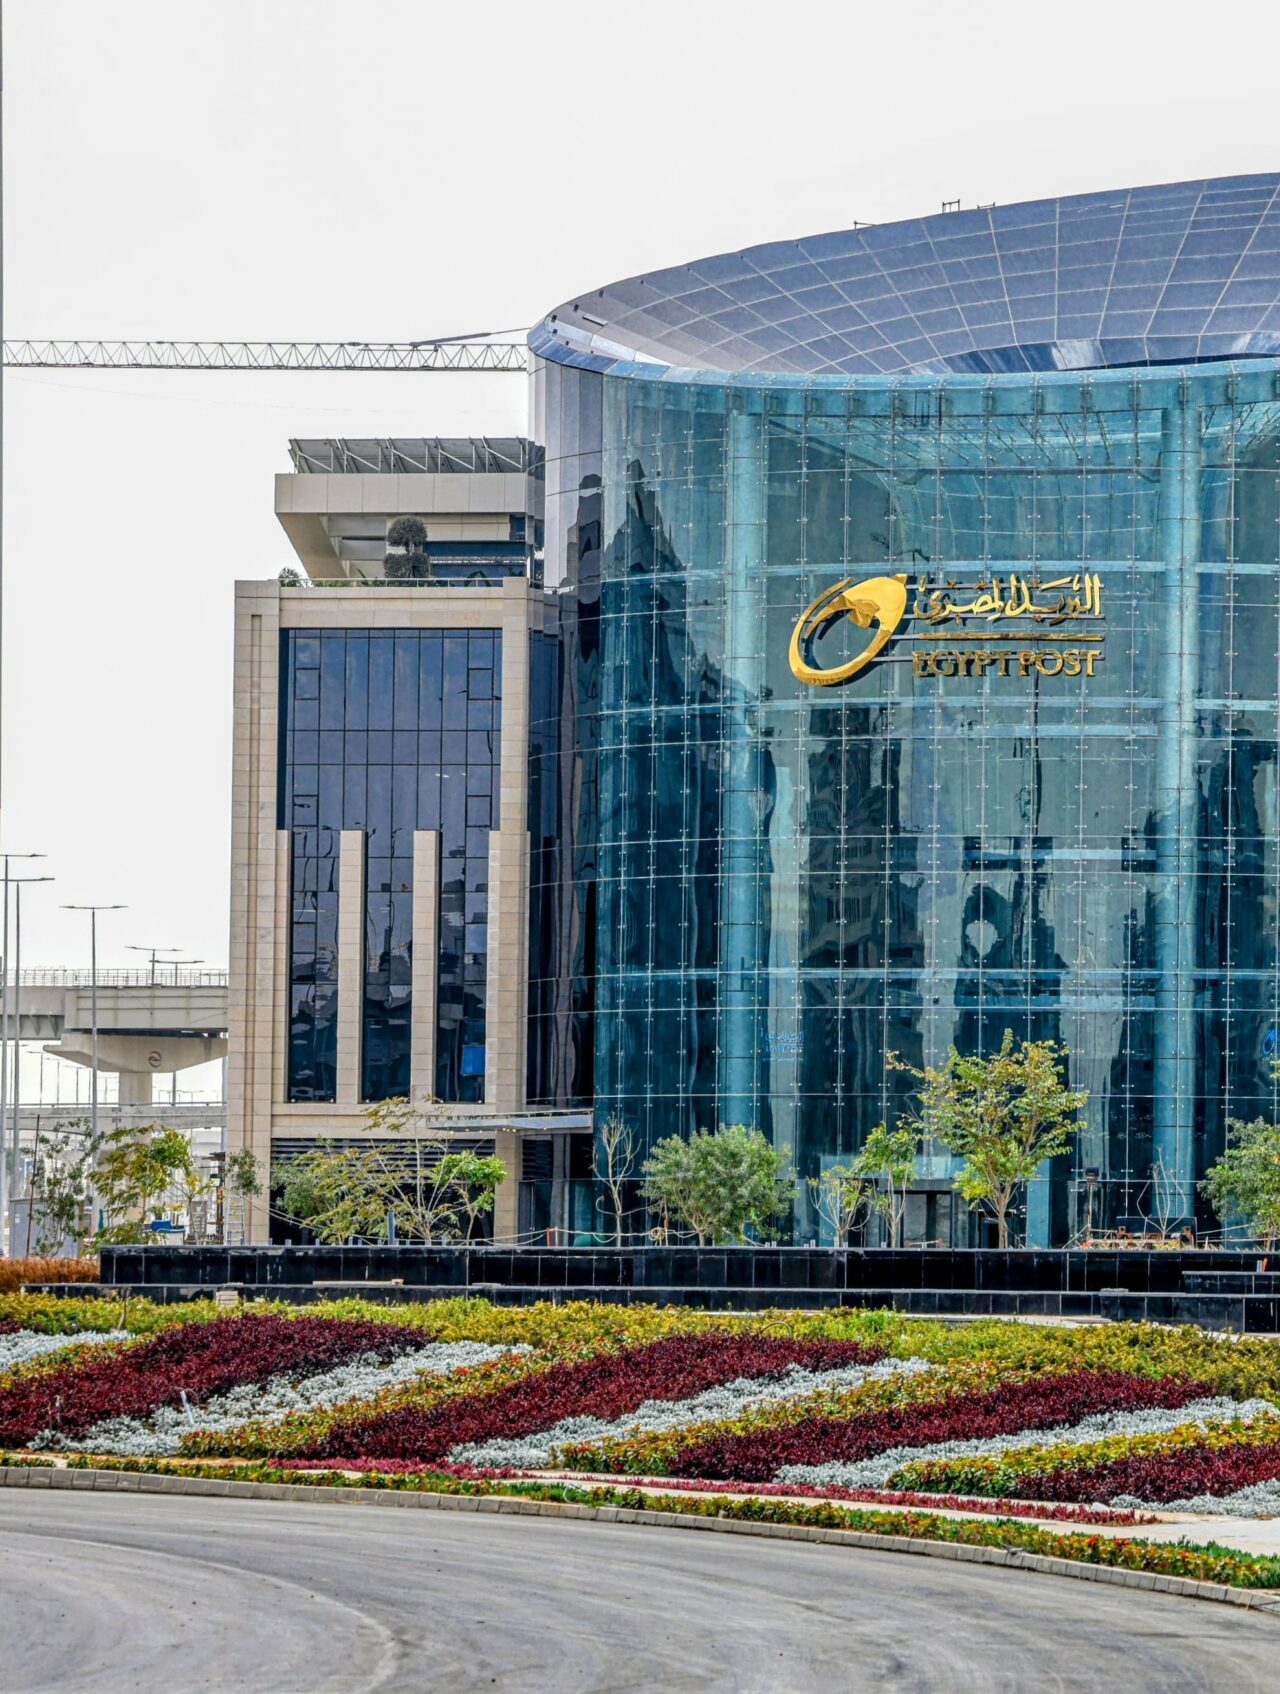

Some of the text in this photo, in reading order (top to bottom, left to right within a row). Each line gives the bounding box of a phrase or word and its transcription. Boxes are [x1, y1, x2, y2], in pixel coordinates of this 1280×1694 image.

[1005, 573, 1101, 626] البريد
[912, 650, 1101, 676] EGYPT POST
